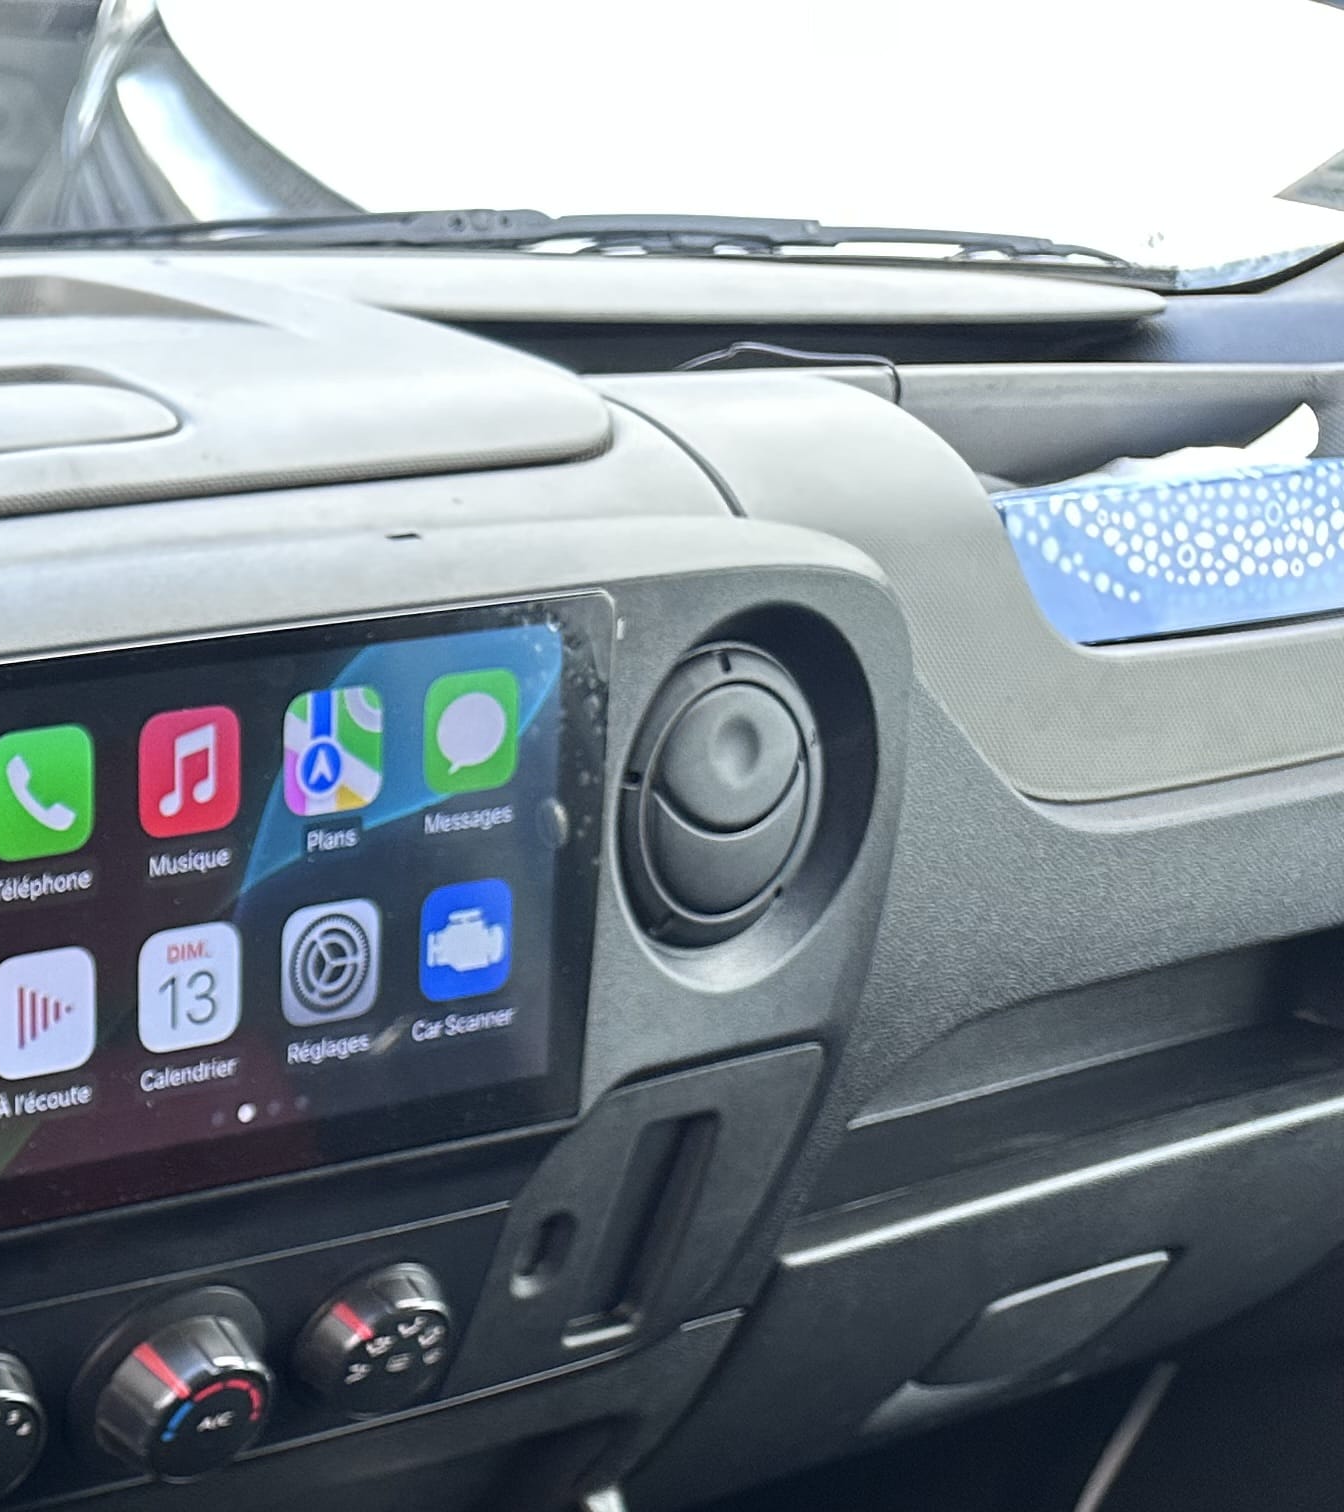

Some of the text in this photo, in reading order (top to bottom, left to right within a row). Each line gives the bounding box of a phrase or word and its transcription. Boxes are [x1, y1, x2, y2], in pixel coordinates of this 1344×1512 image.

[424, 805, 514, 835] Messages
[307, 828, 360, 853] Plans
[149, 848, 231, 878] Musique
[167, 941, 211, 964] DIM.
[158, 970, 216, 1030] 13
[412, 1007, 518, 1042] Car Scanner
[288, 1033, 370, 1064] Réglages
[140, 1057, 240, 1092] Calendrier
